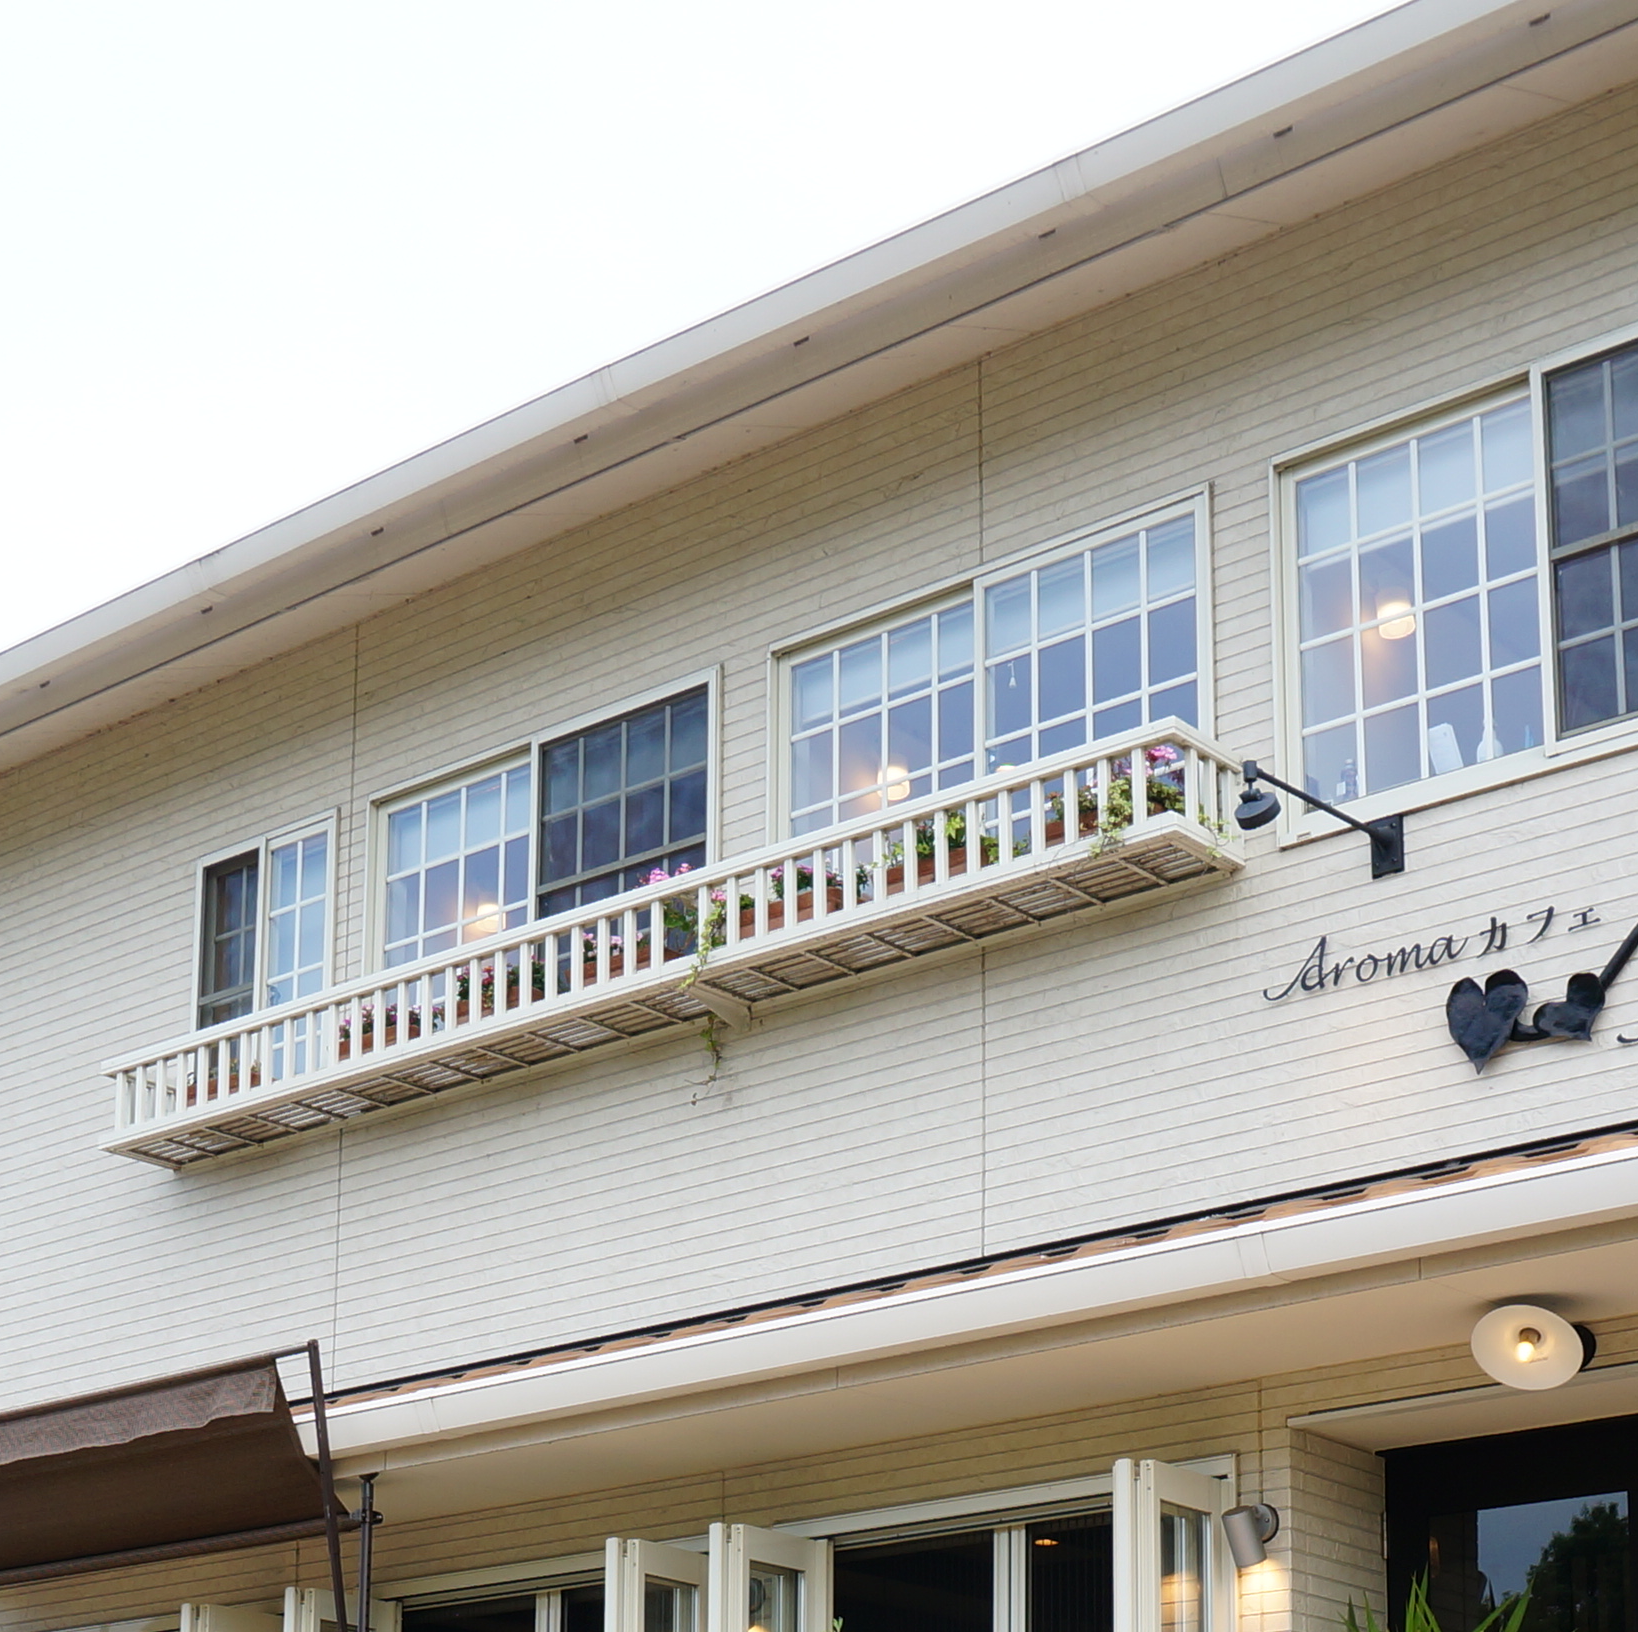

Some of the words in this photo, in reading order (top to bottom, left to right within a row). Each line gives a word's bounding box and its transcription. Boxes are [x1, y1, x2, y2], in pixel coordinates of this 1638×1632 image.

[1262, 934, 1469, 1001] Aroma
[1478, 905, 1602, 957] カフェ
